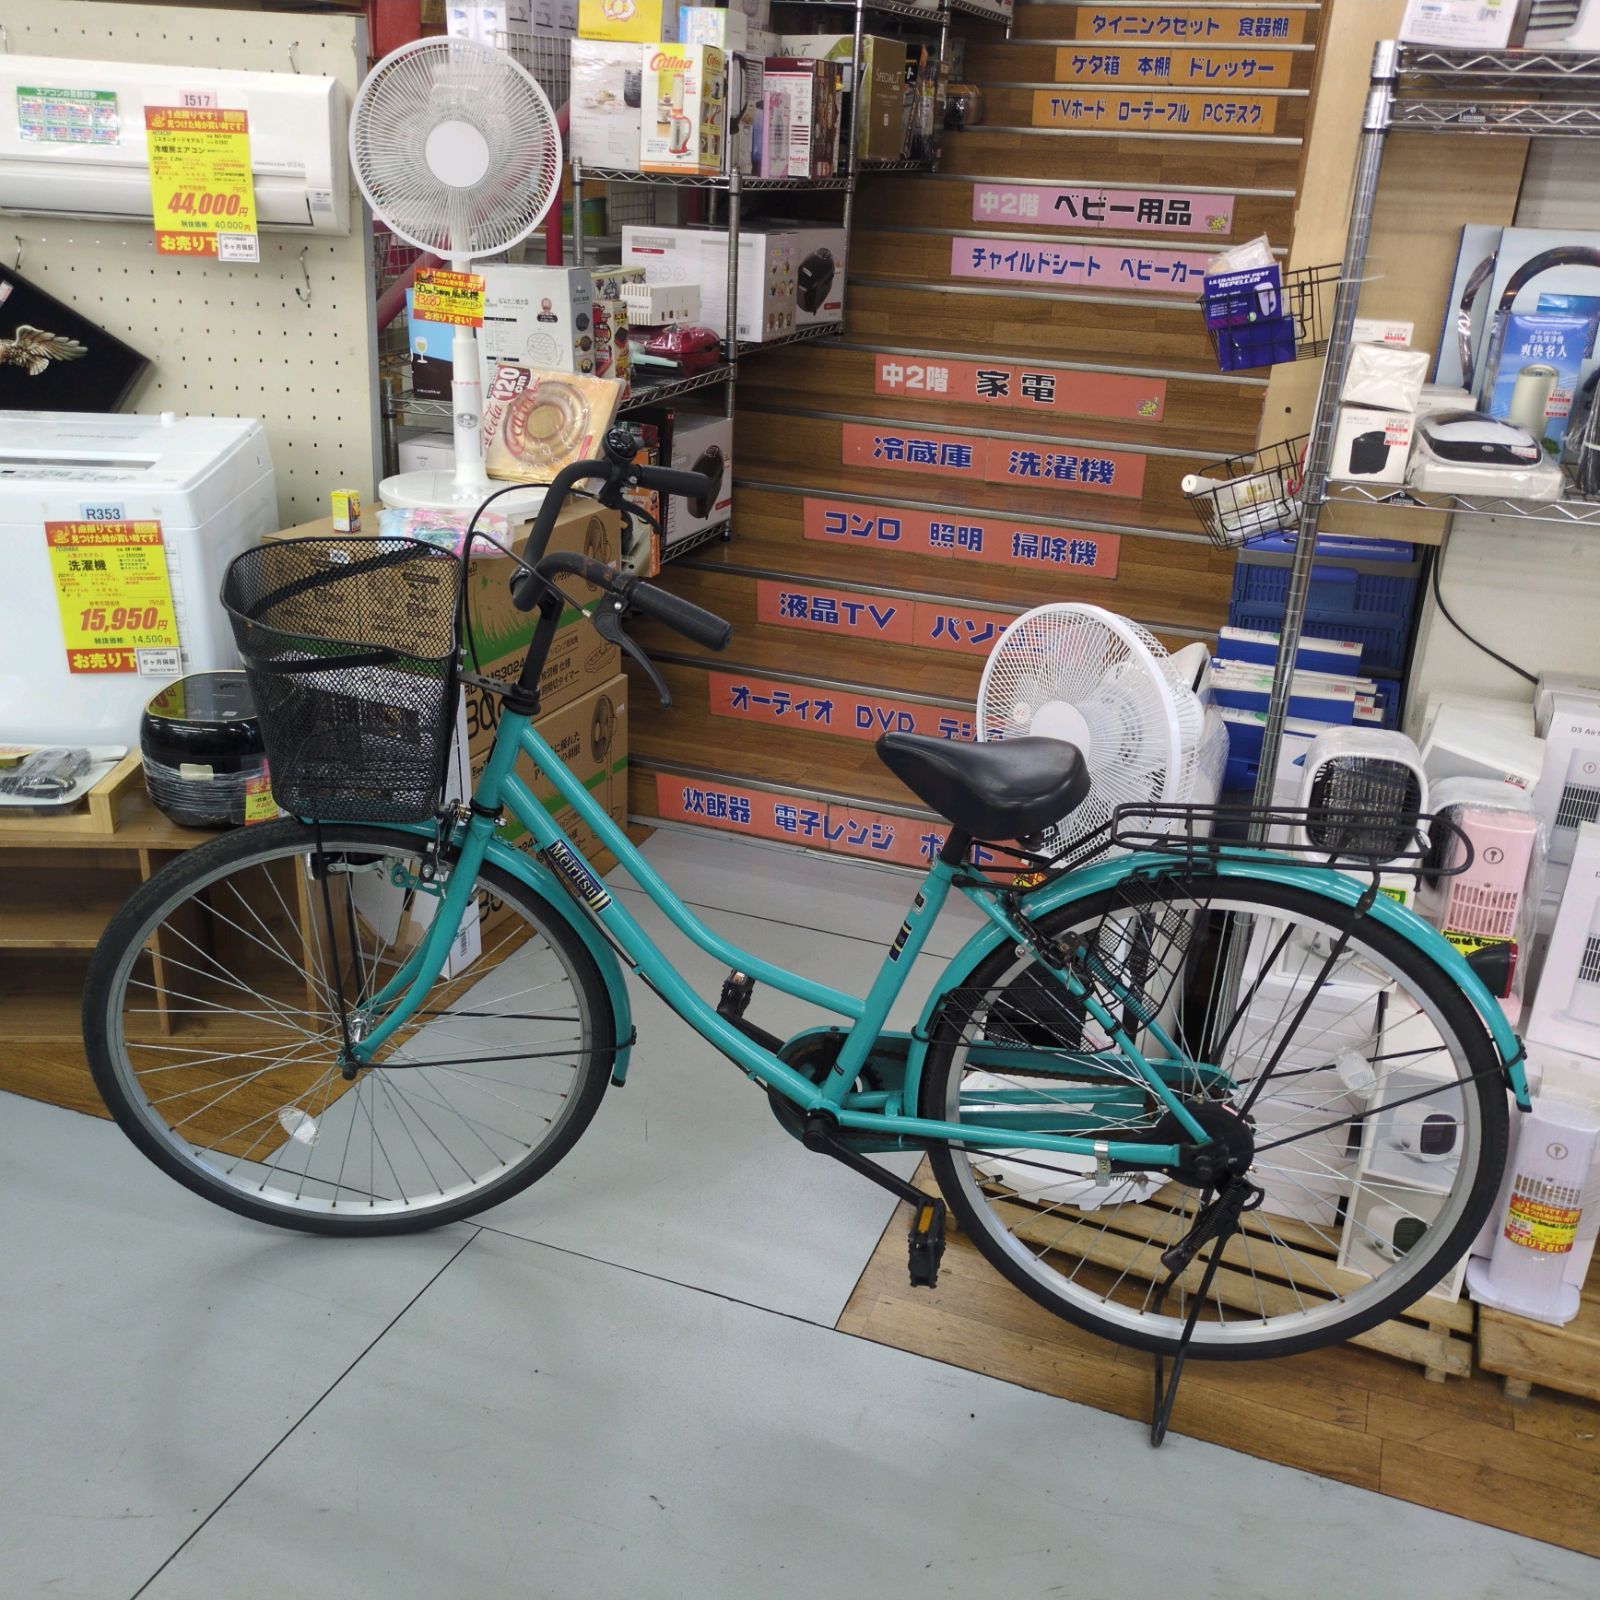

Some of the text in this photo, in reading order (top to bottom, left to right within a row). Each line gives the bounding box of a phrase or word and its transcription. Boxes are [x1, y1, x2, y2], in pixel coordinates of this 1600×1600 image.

[1238, 17, 1290, 38] 食器棚
[1071, 55, 1275, 78] ゲタ箱 本棚 ドレッサー
[978, 192, 1193, 227] 中2階 ベビー用品
[971, 247, 1205, 283] チャイルドシート ベビーカー
[1218, 276, 1261, 289] REPELLER
[881, 362, 949, 393] 中2階
[872, 436, 1115, 486] 冷蔵庫 洗濯機
[86, 508, 121, 520] R353
[824, 510, 1098, 568] コンロ 照明 掃除機
[68, 559, 108, 572] 洗濯機
[80, 606, 169, 633] 15,950円
[779, 592, 897, 631] 液晶TV
[729, 685, 834, 725] オーディオ
[855, 704, 916, 734] DVD
[682, 786, 752, 824] 炊飯器
[774, 803, 895, 851] 電子レンジ
[550, 842, 597, 898] Meiritsu
